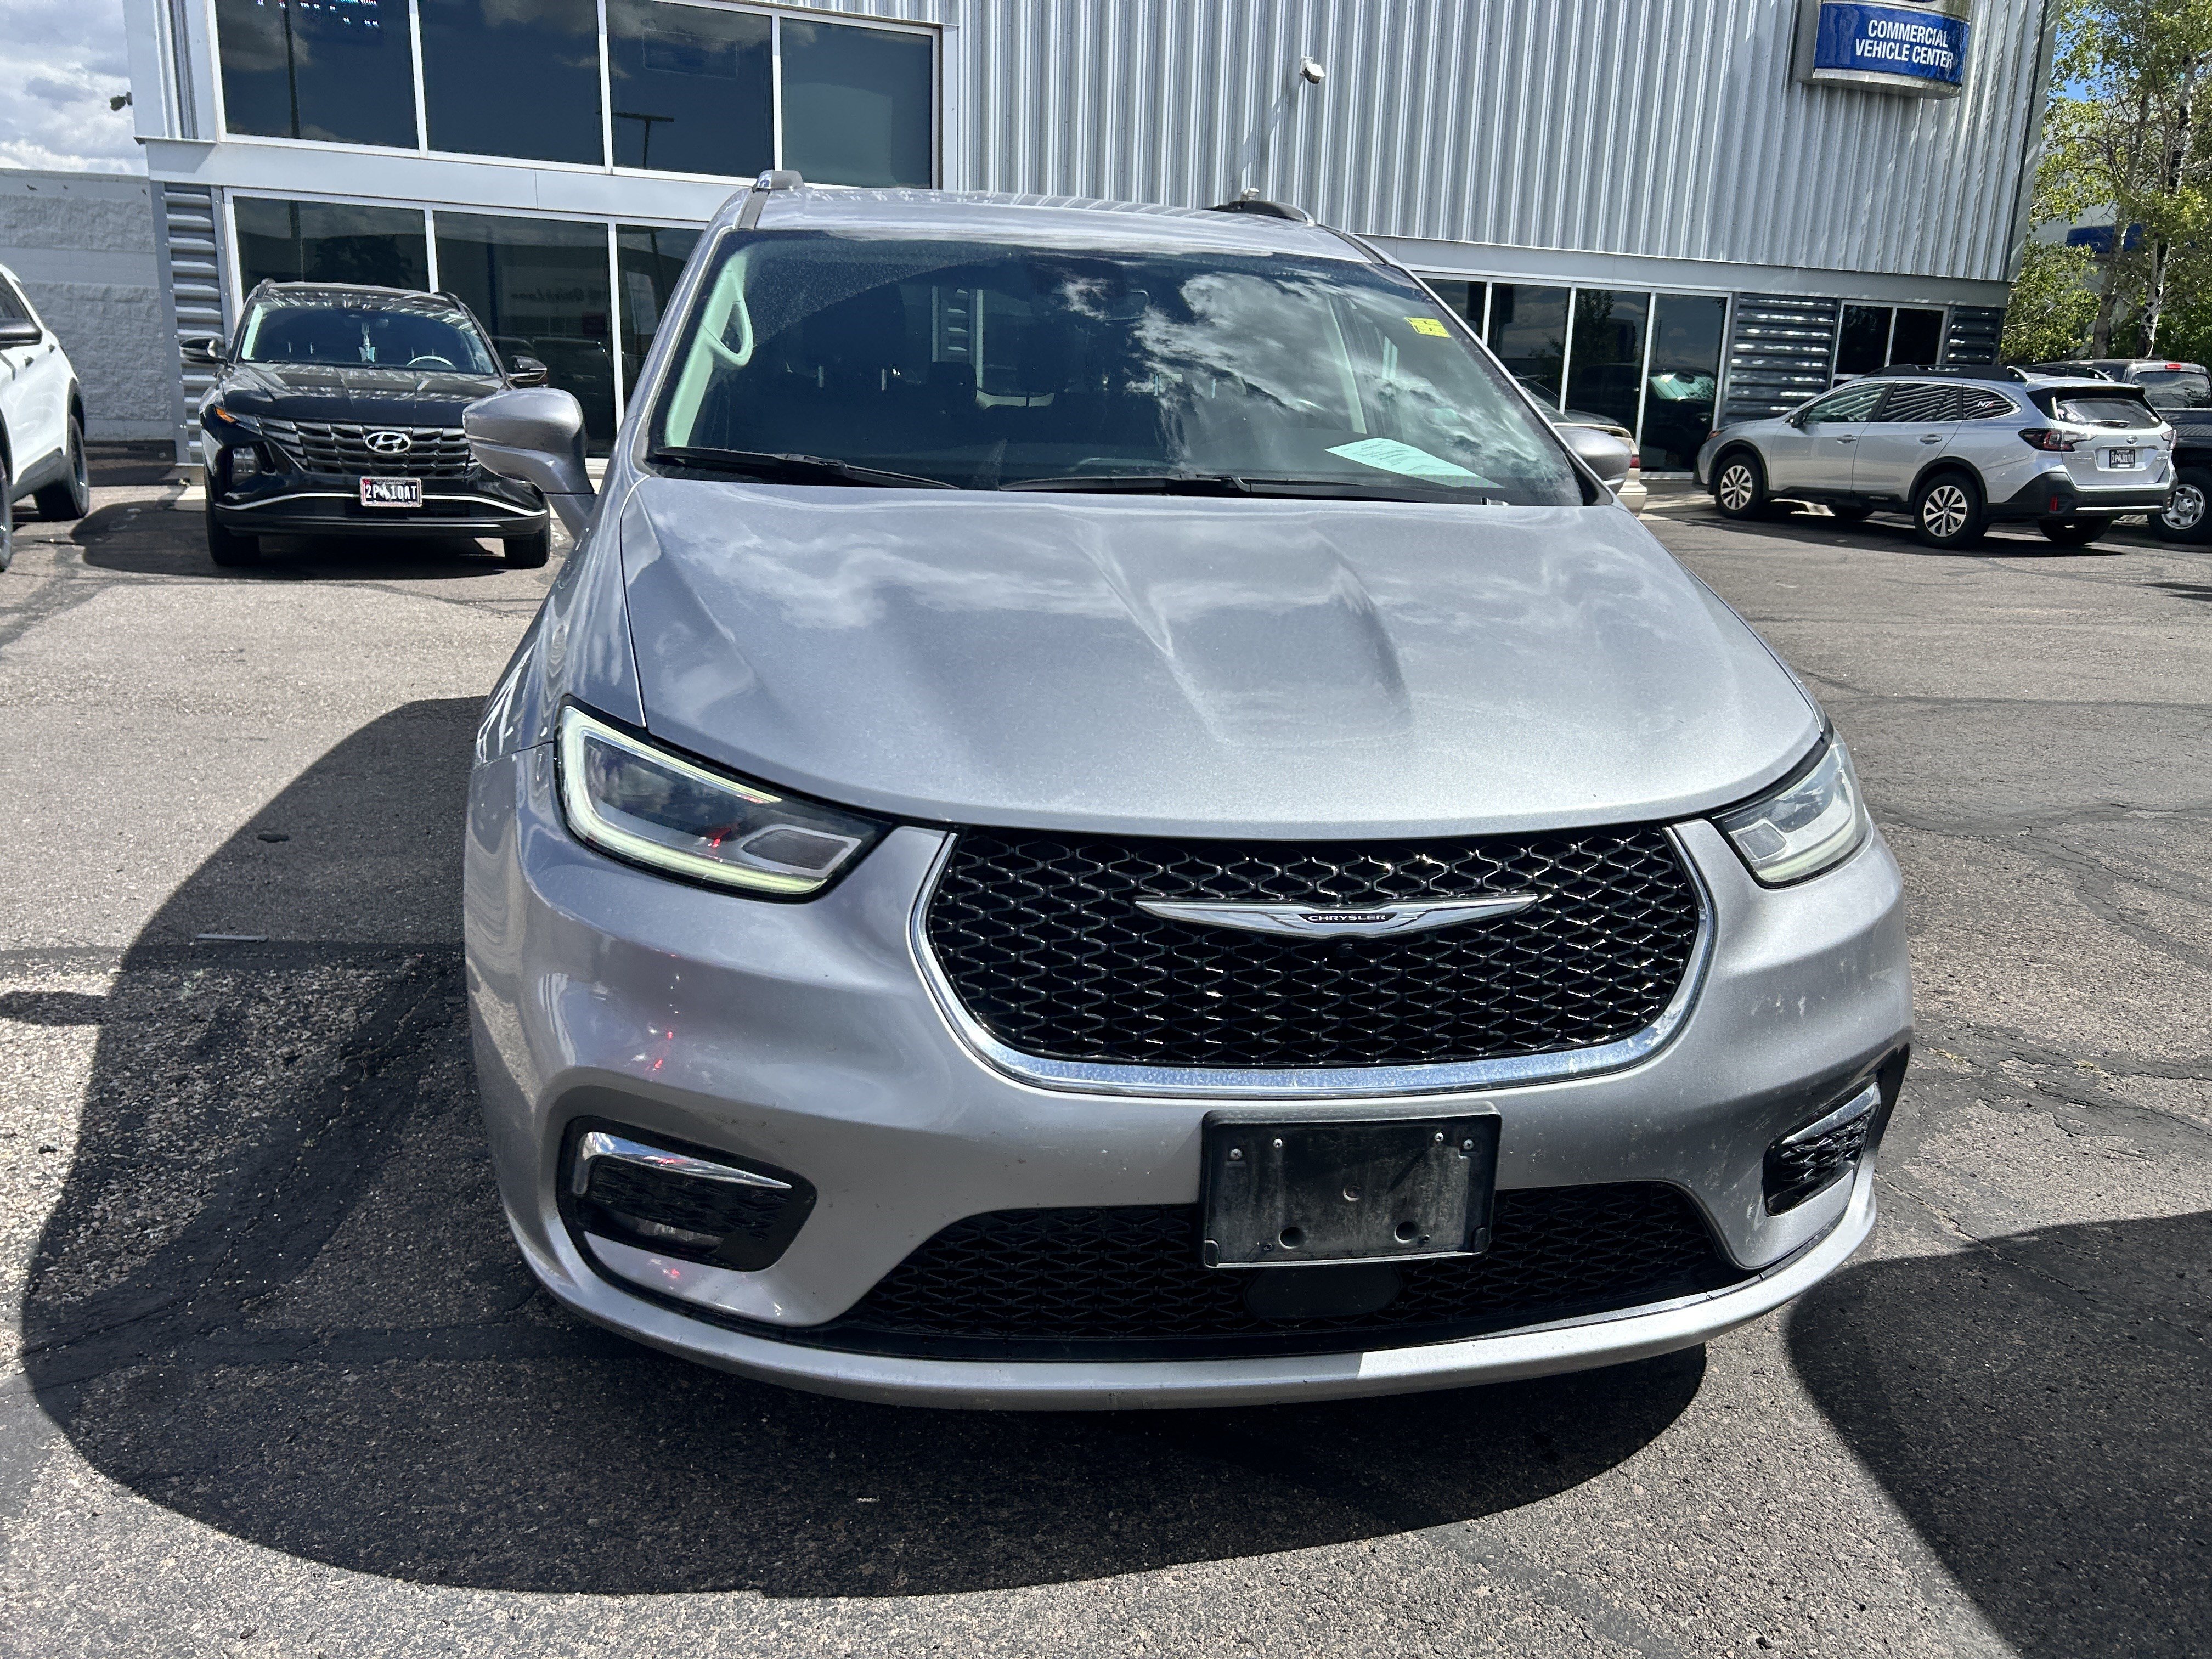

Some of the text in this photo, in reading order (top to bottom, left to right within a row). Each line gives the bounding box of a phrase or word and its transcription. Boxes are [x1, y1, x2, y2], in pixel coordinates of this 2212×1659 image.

[1868, 19, 1948, 48] COMMERCIAL
[1855, 39, 1953, 69] VEHICLE CENTER
